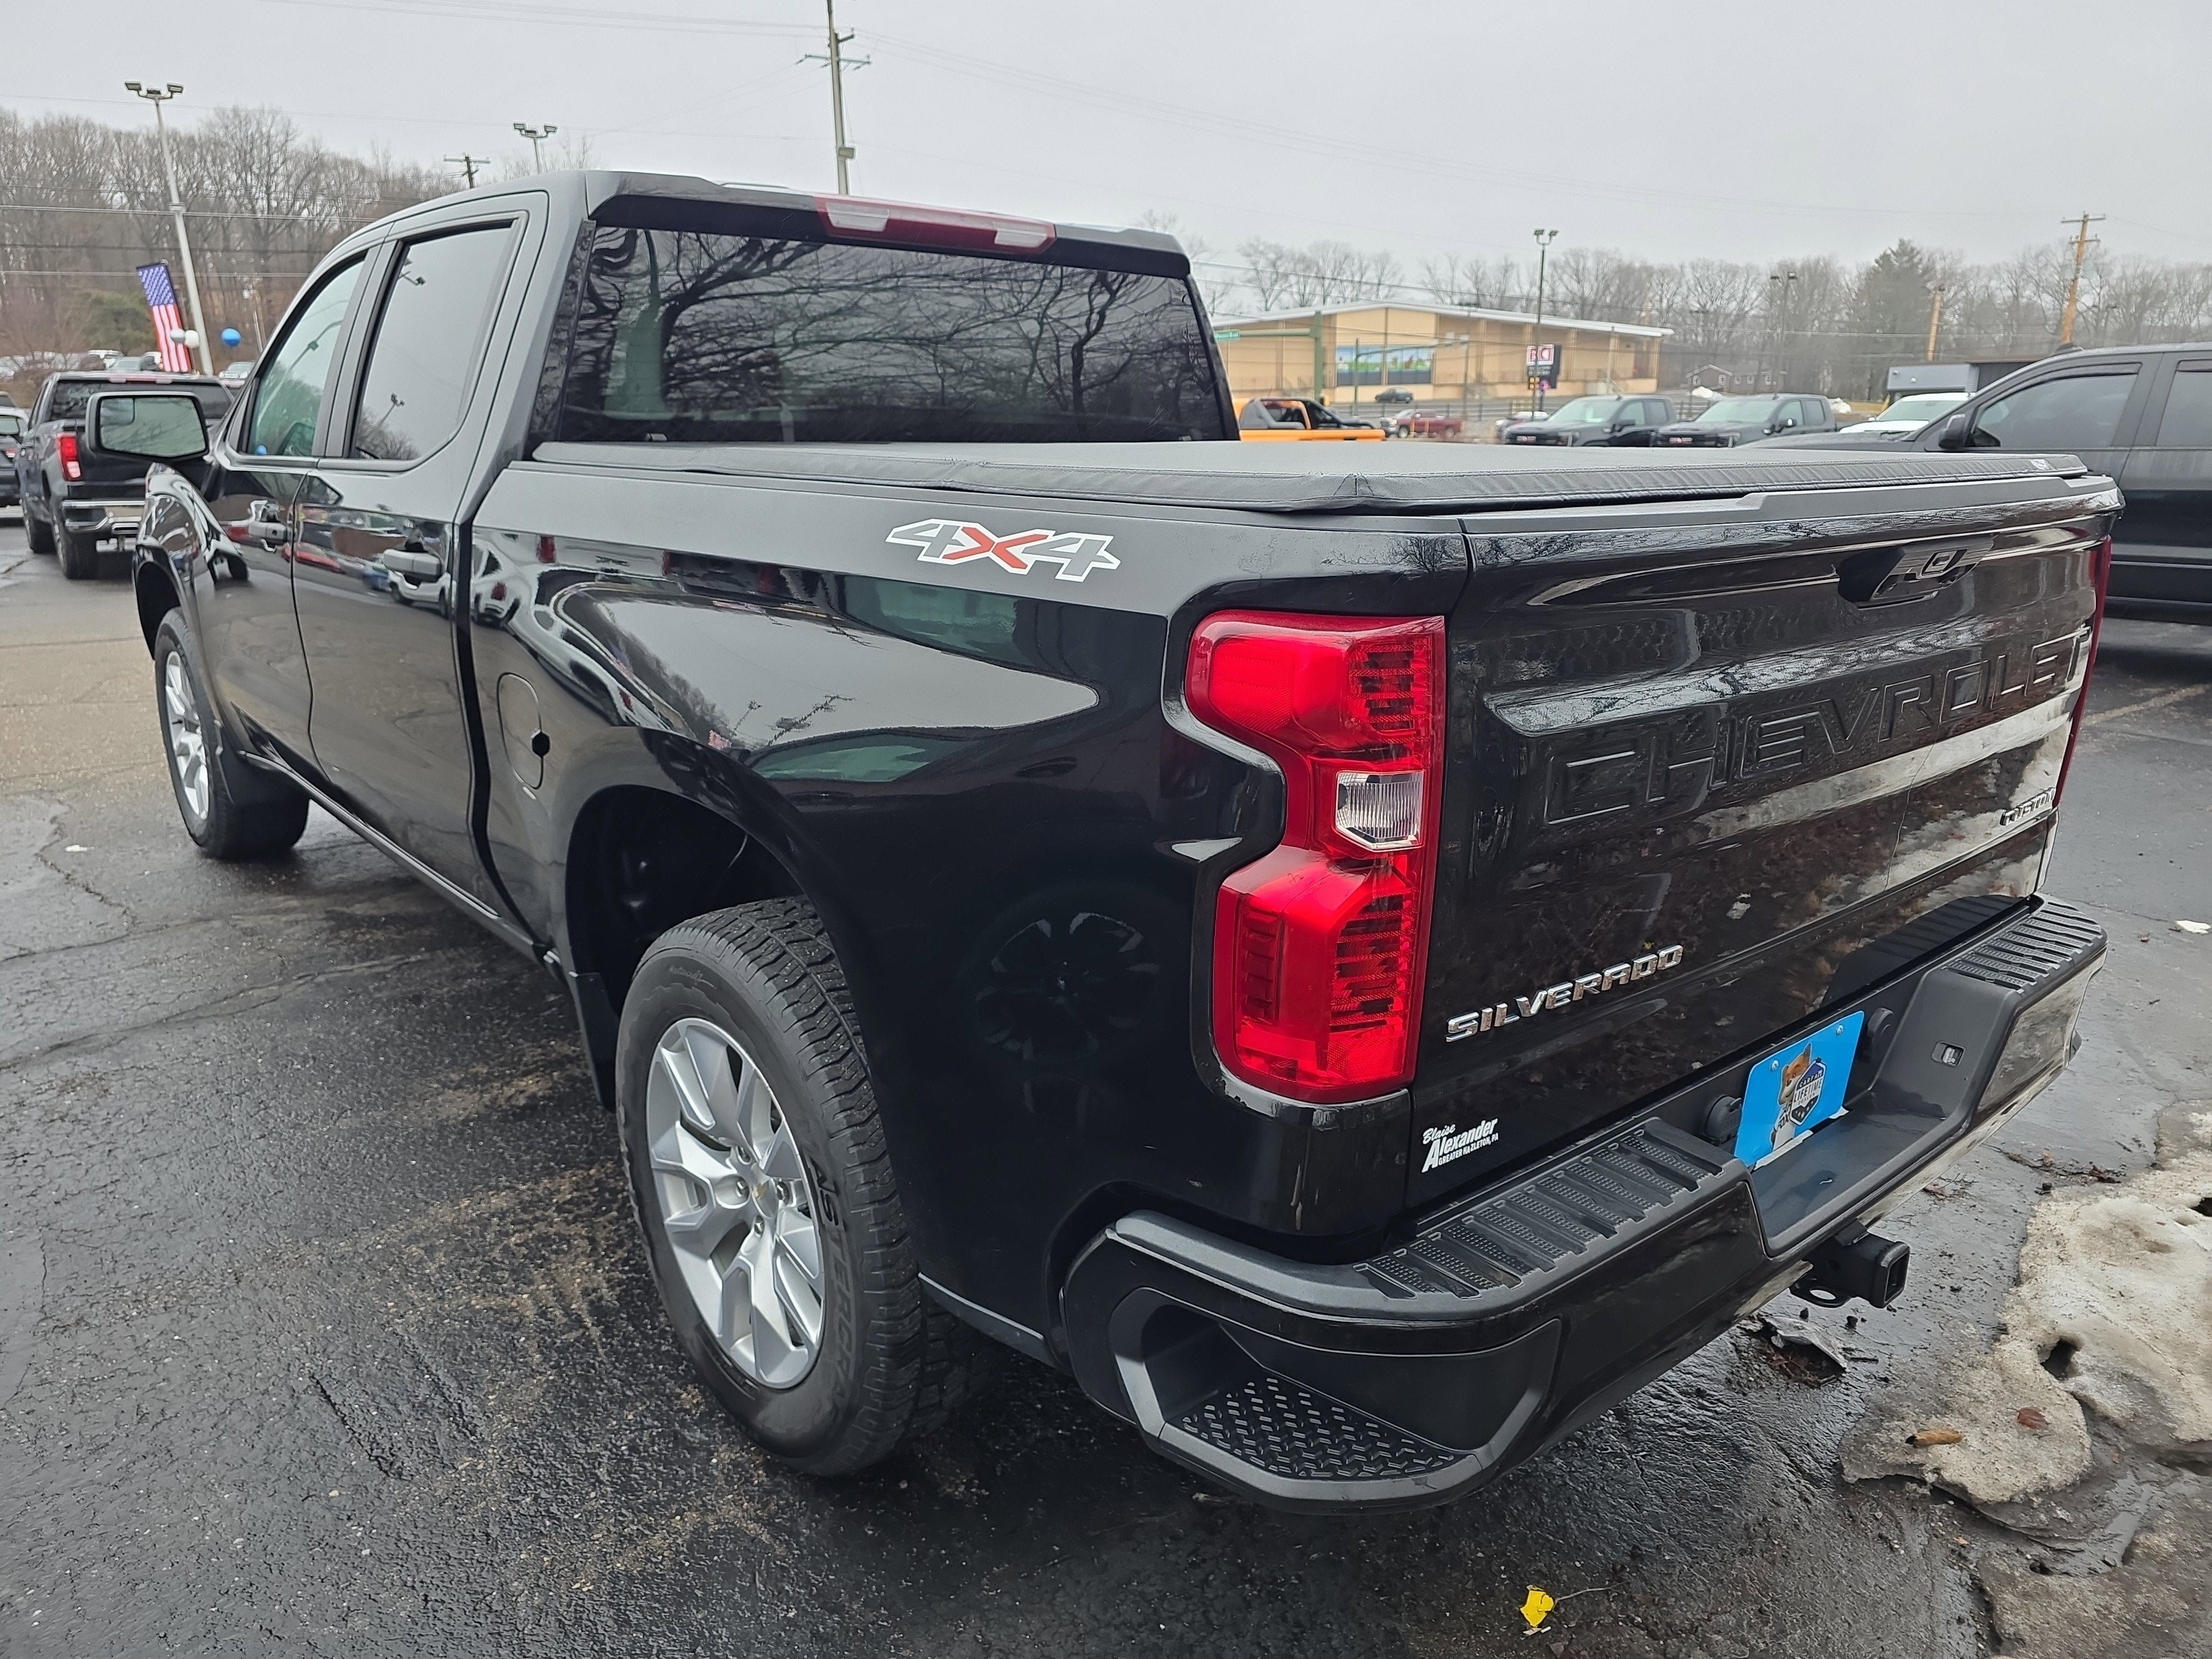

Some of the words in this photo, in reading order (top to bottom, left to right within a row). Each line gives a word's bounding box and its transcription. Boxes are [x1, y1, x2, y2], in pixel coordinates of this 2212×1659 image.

[1542, 626, 2092, 826] CHEVROLET
[1445, 944, 1683, 1043] SILVERADO
[1793, 1078, 1822, 1103] LIFETIME
[1423, 1124, 1456, 1144] Blaise
[1777, 1112, 1790, 1130] FOX
[1422, 1118, 1498, 1173] Alexander
[1438, 1148, 1463, 1166] GREATER
[1491, 1133, 1499, 1142] PA
[799, 1118, 856, 1431] ASTERCRA
